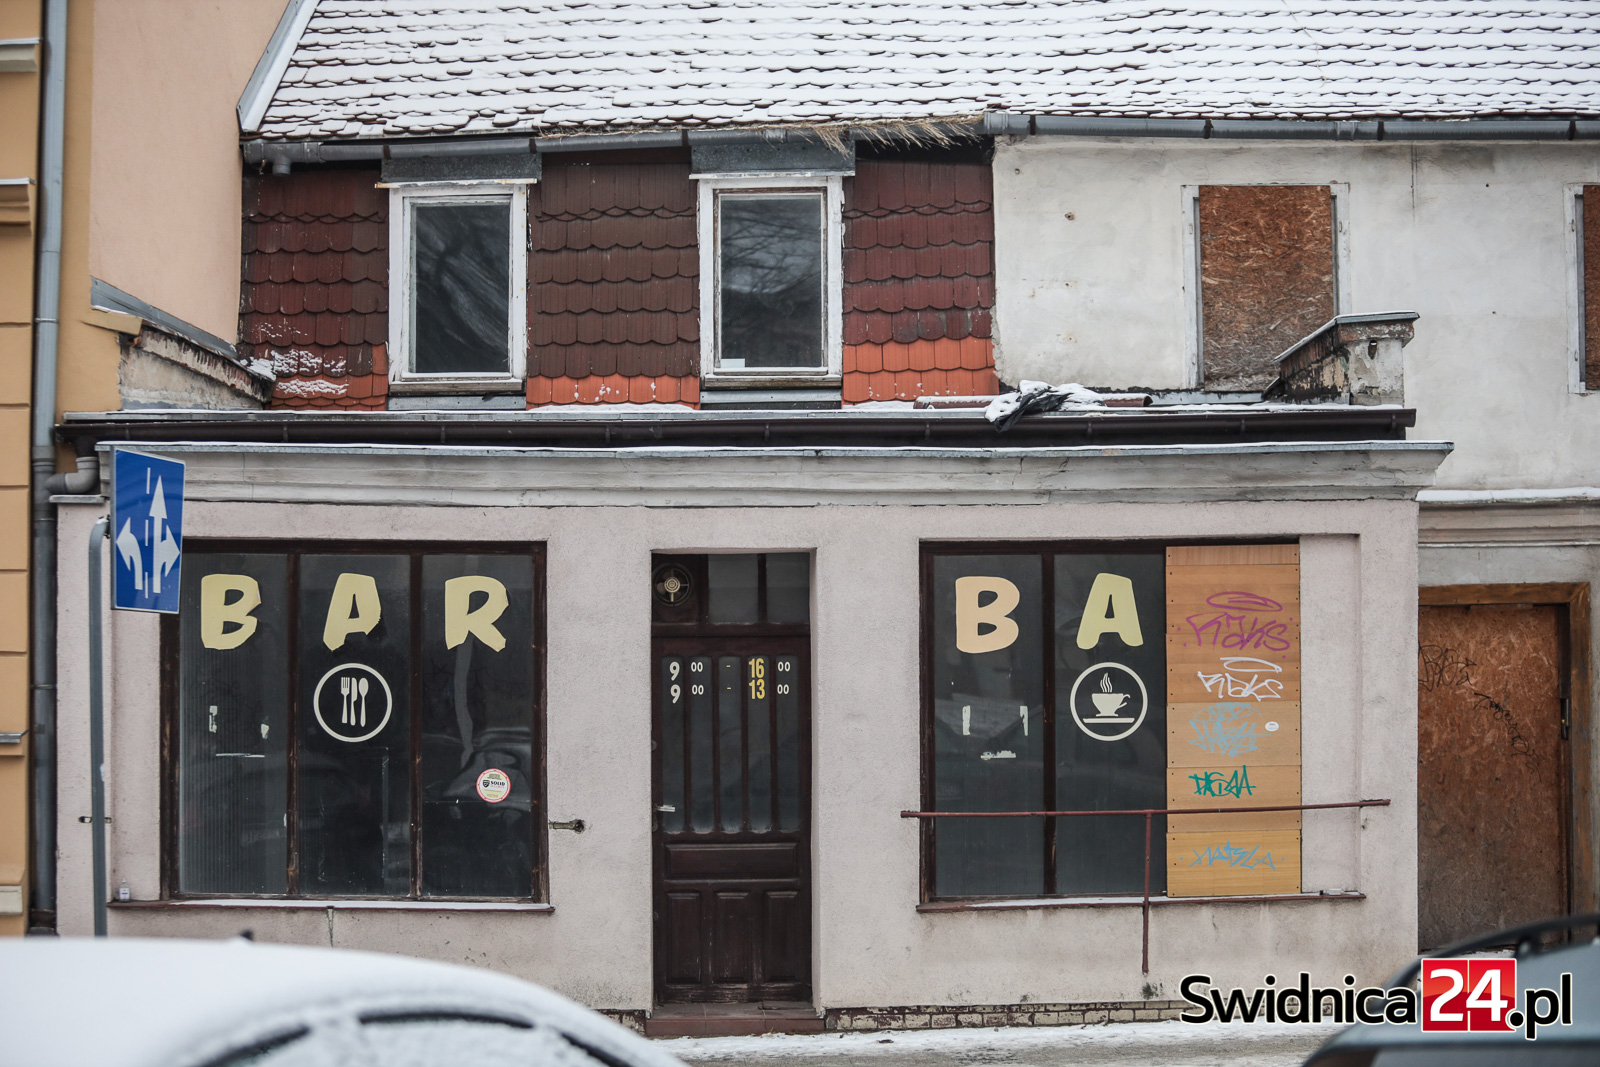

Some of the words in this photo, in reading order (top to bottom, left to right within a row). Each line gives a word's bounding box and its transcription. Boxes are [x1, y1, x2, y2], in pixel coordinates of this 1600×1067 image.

[201, 572, 510, 652] BAR
[669, 661, 680, 681] 9
[690, 661, 703, 672] 00
[748, 658, 765, 679] 16
[777, 661, 791, 672] 00
[670, 684, 681, 704] 9
[691, 684, 704, 695] 00
[748, 678, 766, 700] 13
[777, 684, 790, 695] 00
